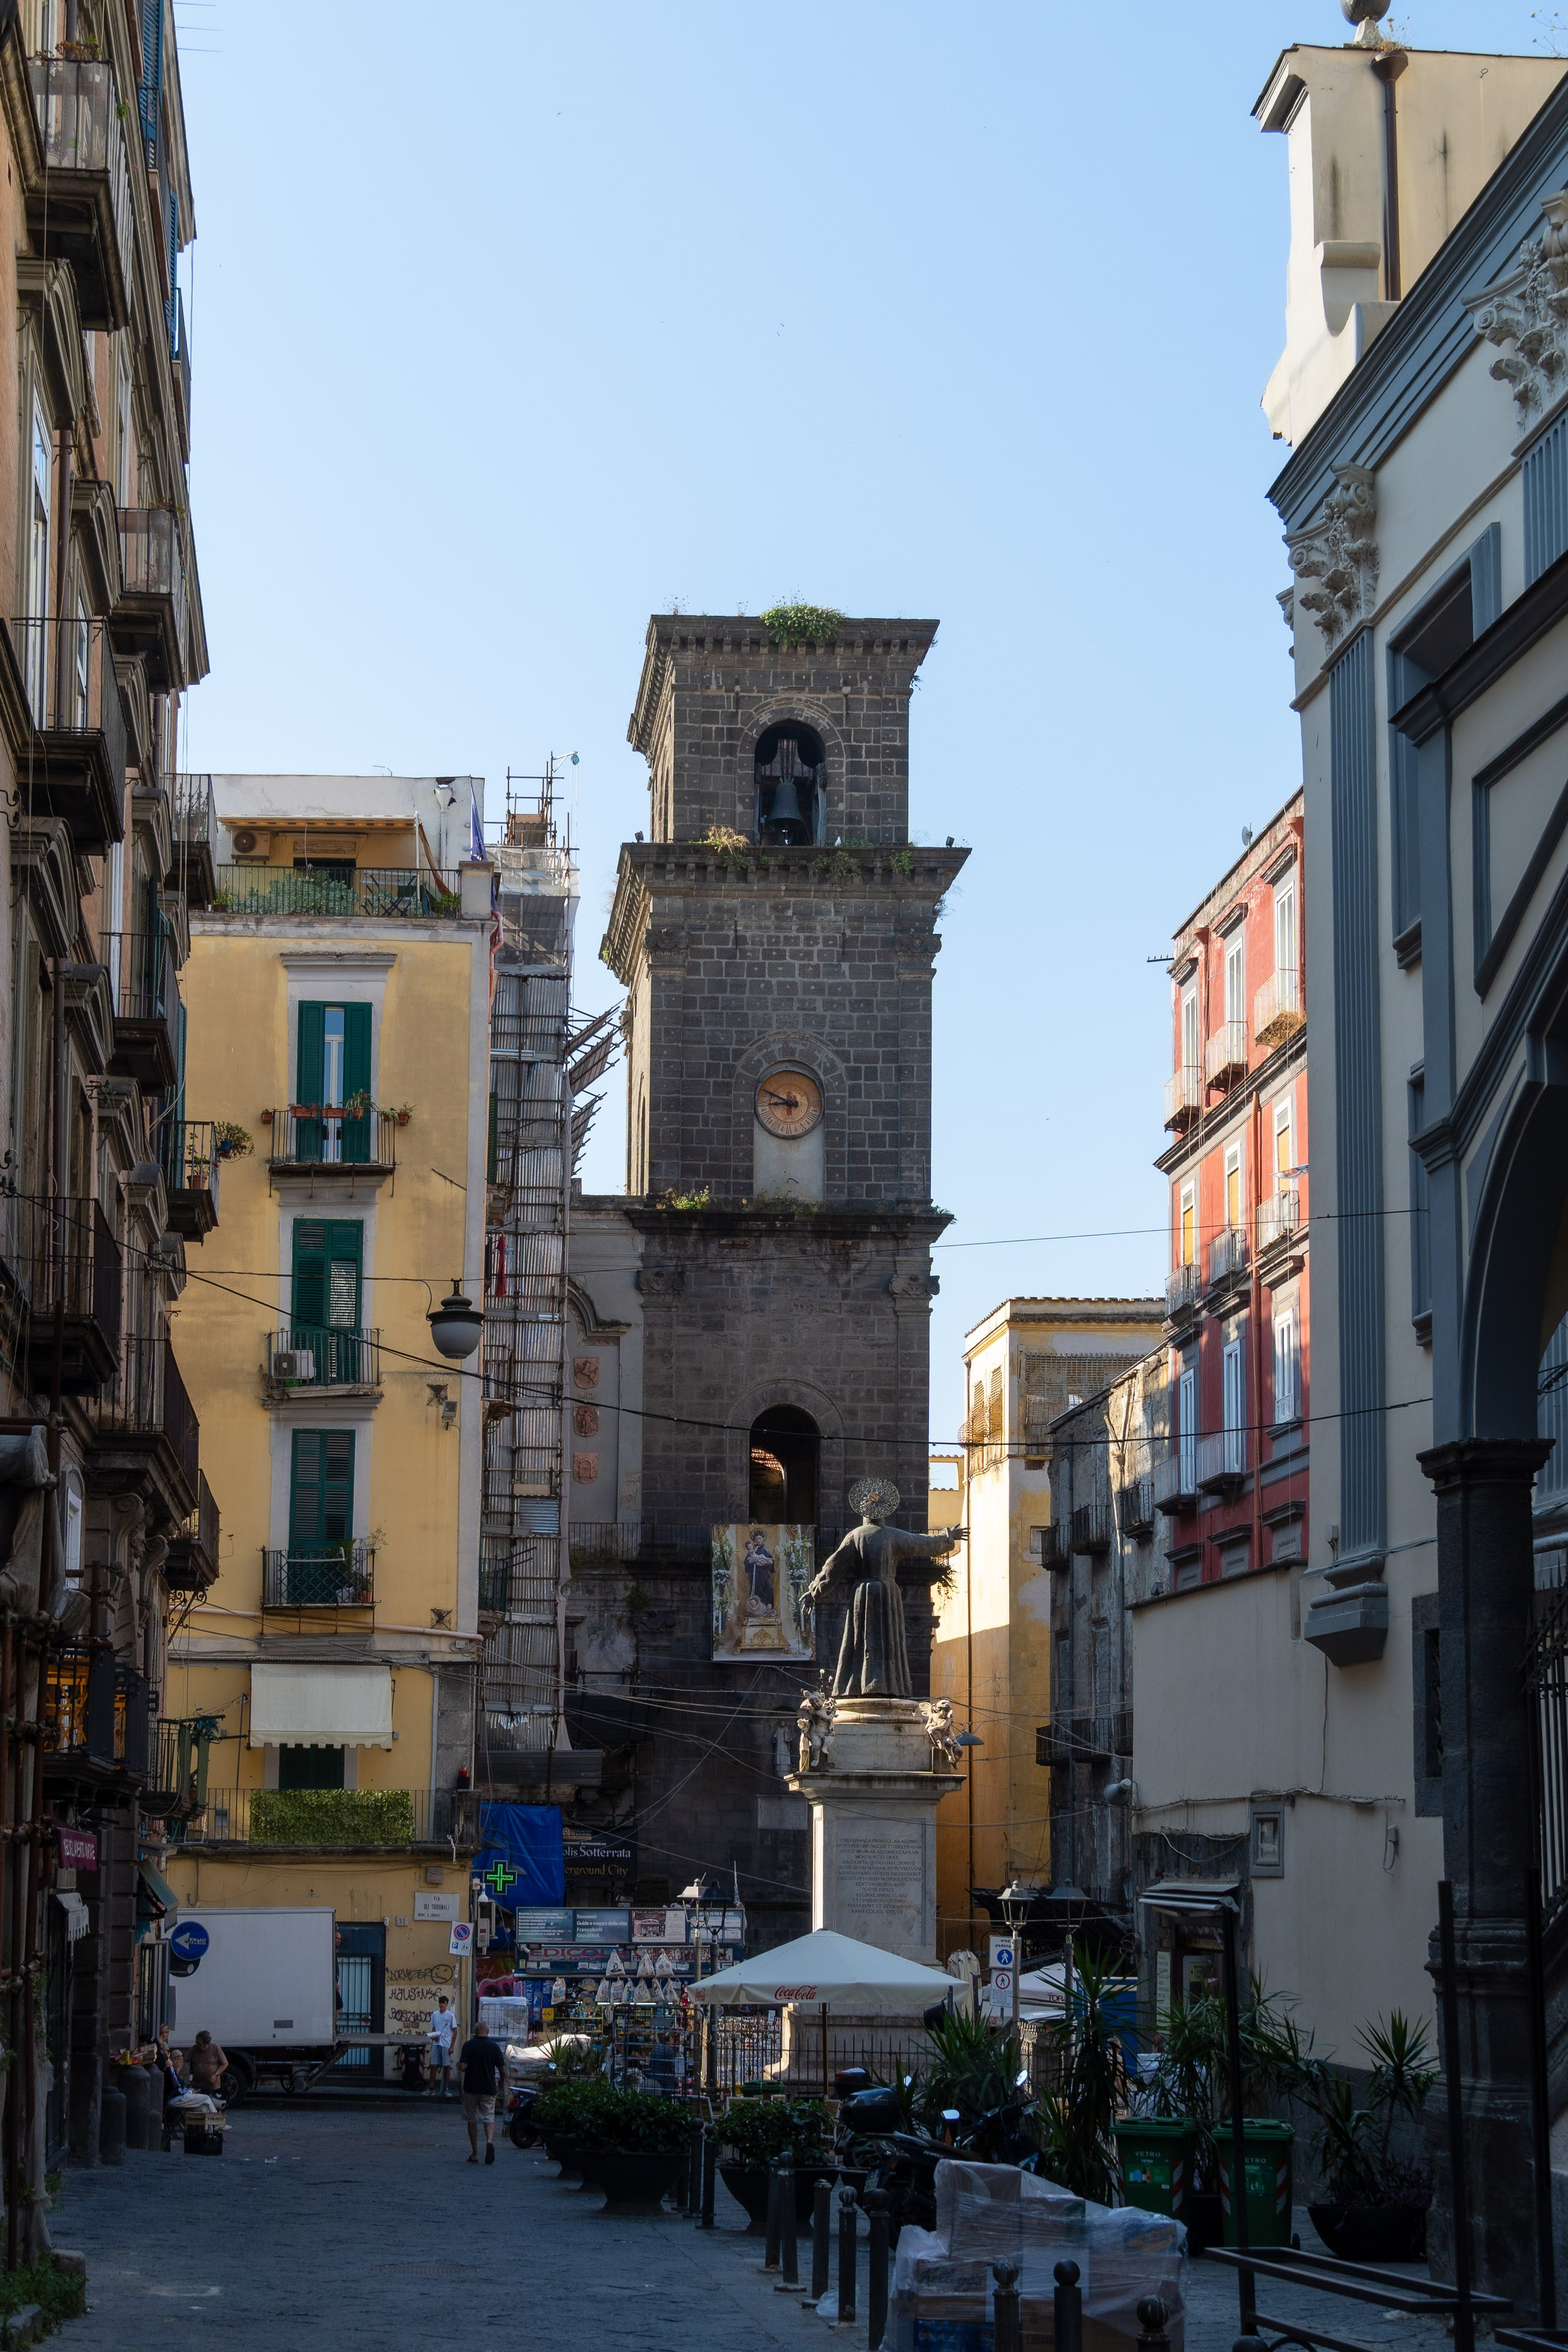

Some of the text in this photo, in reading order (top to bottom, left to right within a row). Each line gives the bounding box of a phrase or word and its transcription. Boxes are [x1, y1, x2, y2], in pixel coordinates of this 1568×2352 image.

[563, 1845, 631, 1858] olis Sotterrata
[564, 1864, 628, 1878] erground City
[774, 1985, 819, 2000] Coca-Cola
